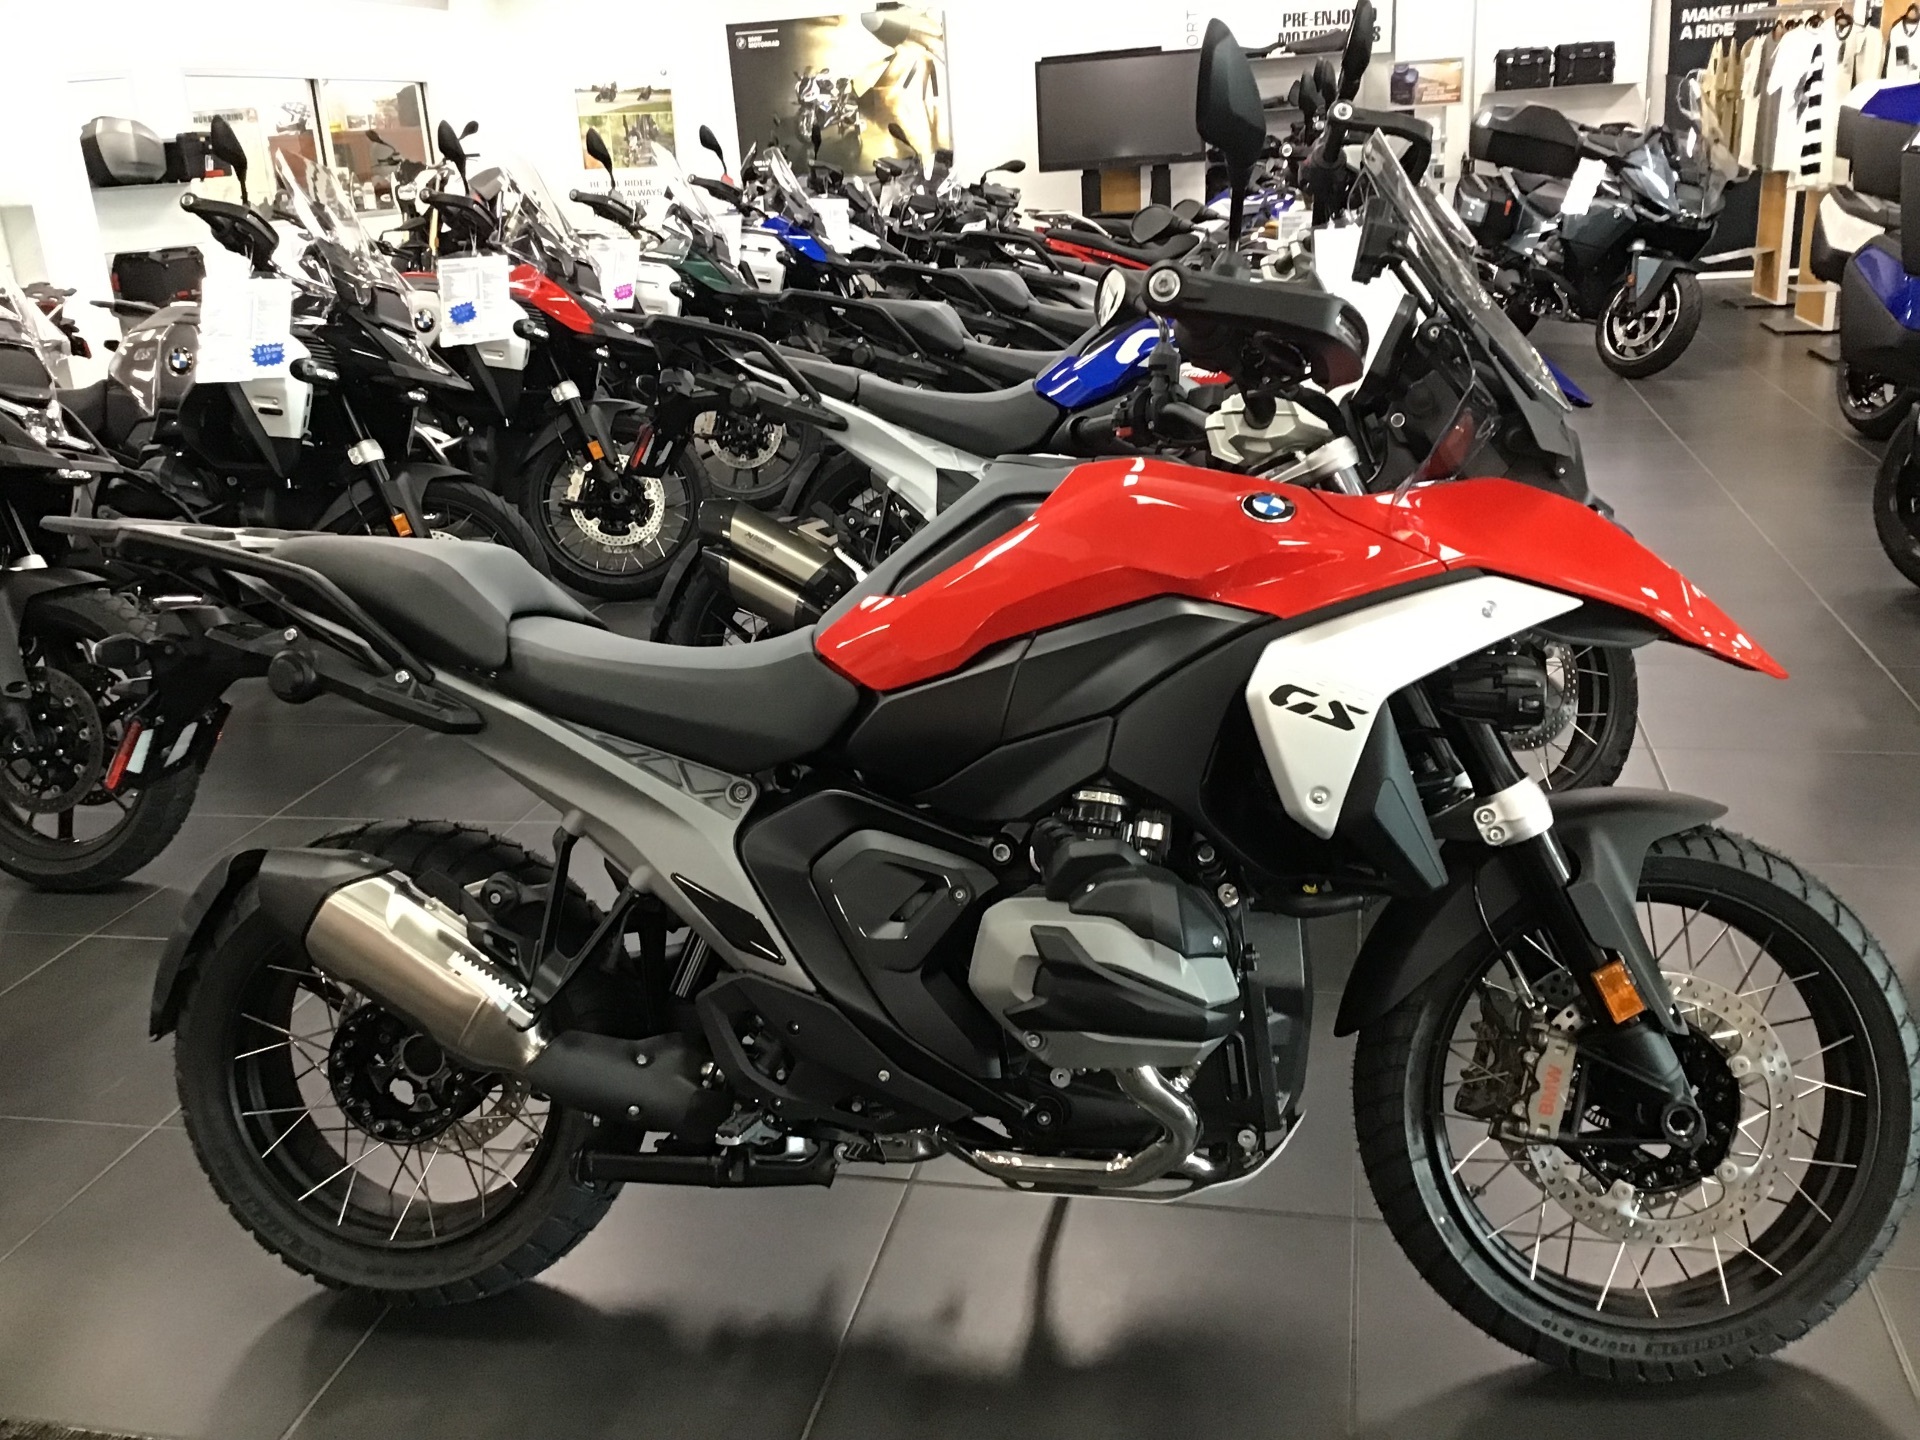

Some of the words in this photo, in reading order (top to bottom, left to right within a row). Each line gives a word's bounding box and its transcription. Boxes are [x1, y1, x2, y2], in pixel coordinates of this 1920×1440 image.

[1681, 5, 1732, 23] MAKE
[1680, 25, 1693, 40] A
[1695, 22, 1735, 39] RIDE
[625, 179, 651, 187] RIDER
[627, 188, 662, 197] ALWAYS
[1268, 683, 1369, 731] GS
[1538, 1064, 1562, 1116] BMW
